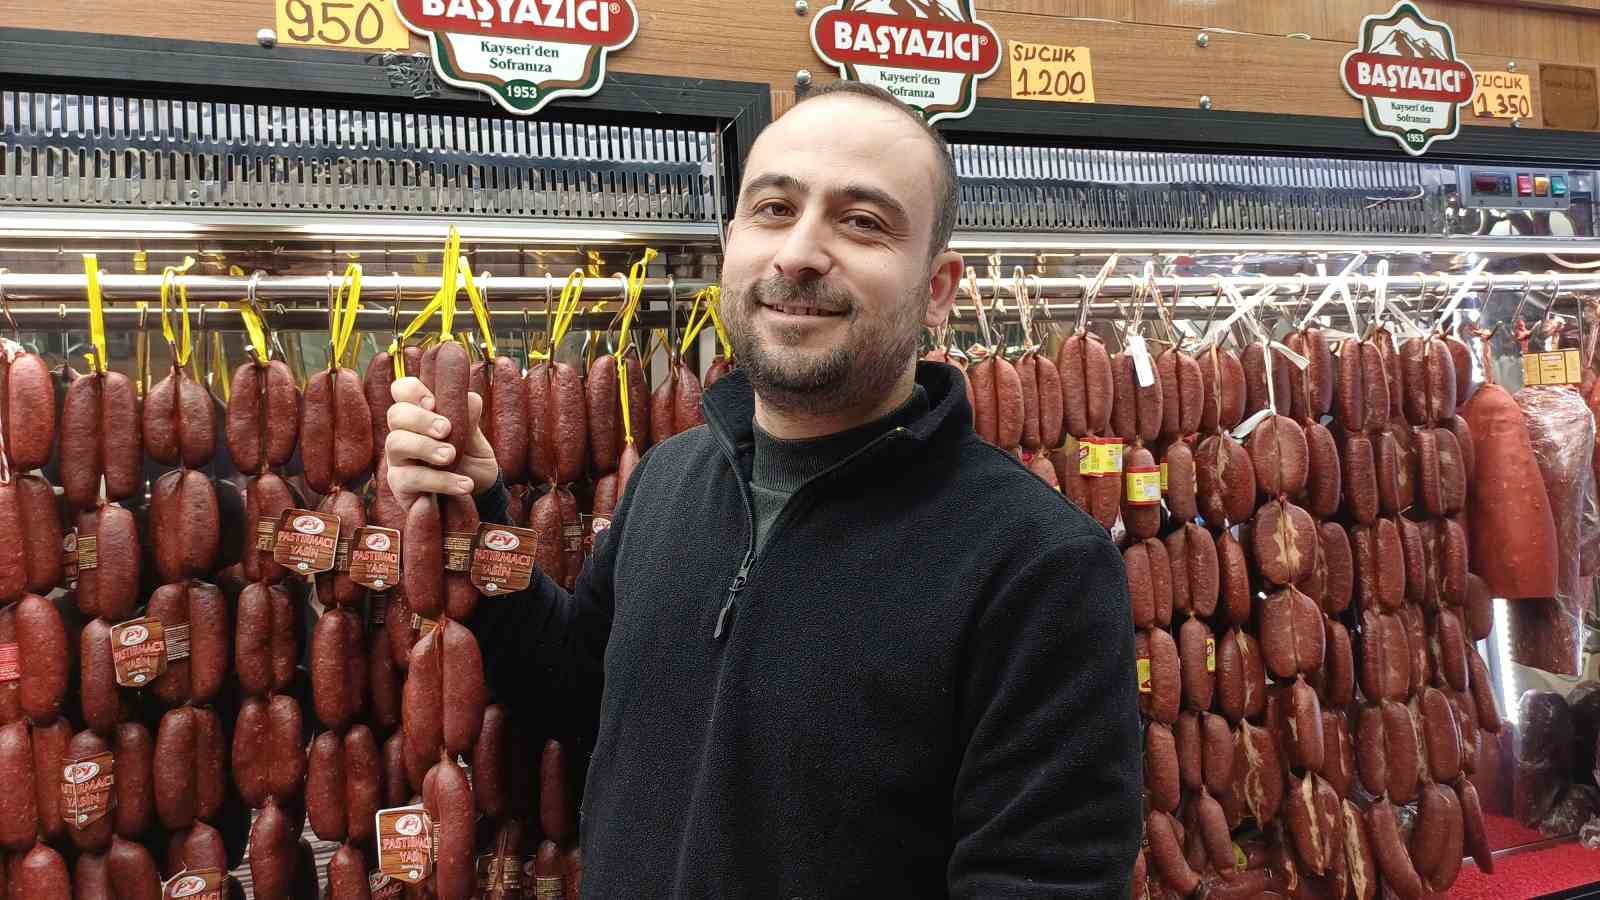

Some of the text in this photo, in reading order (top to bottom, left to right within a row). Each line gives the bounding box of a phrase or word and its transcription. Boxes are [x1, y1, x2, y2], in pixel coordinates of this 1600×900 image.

[285, 0, 384, 44] 950
[480, 41, 560, 59] Kayseri'den
[834, 21, 980, 61] BAŞYAZICI
[1013, 44, 1076, 63] SUCUK
[489, 57, 552, 73] Sofranıza
[879, 70, 940, 86] Kayseri'den
[1016, 67, 1086, 96] 1.200
[1357, 62, 1461, 92] BAŞYAZICI
[1474, 74, 1523, 89] SUCUK
[506, 85, 537, 99] 1953
[1476, 92, 1529, 117] 1.350
[1407, 133, 1424, 142] 1953
